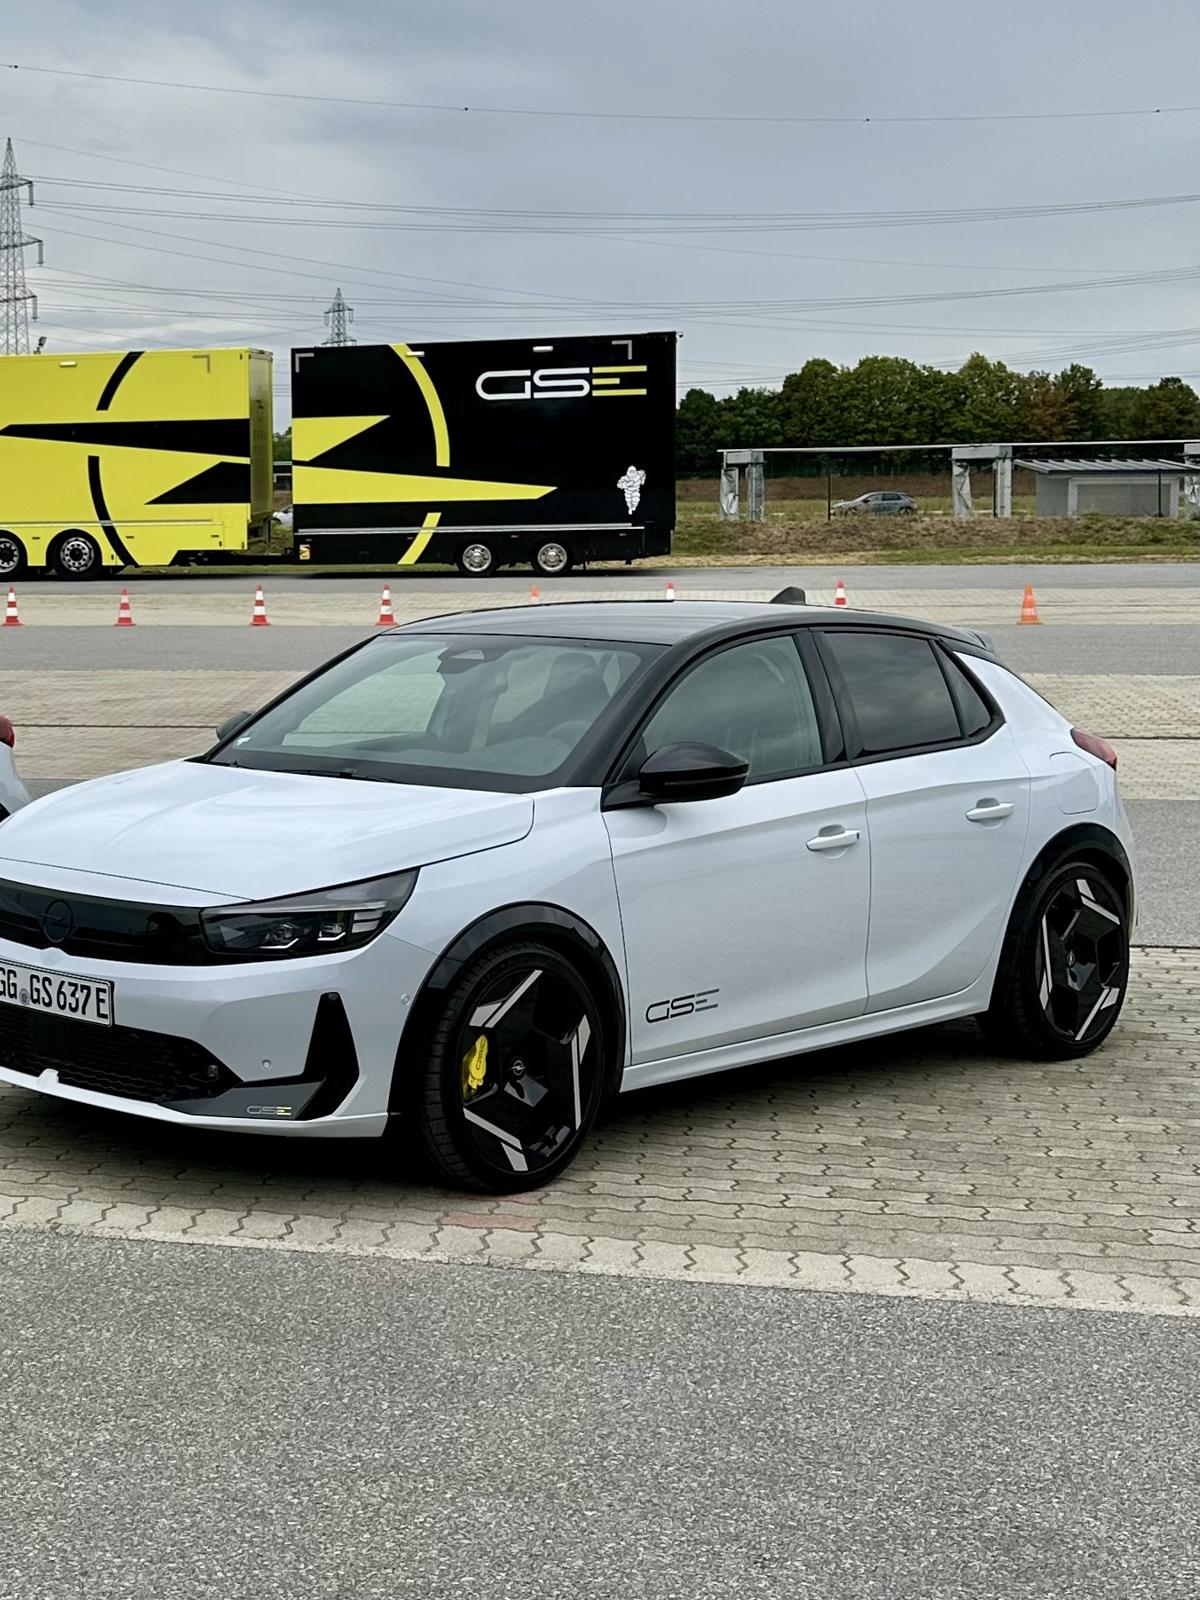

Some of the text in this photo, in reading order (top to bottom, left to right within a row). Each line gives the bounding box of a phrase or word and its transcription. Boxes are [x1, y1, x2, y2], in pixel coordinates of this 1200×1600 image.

[476, 365, 647, 400] GSE
[645, 985, 720, 1023] GSE
[246, 1105, 292, 1116] GSE
